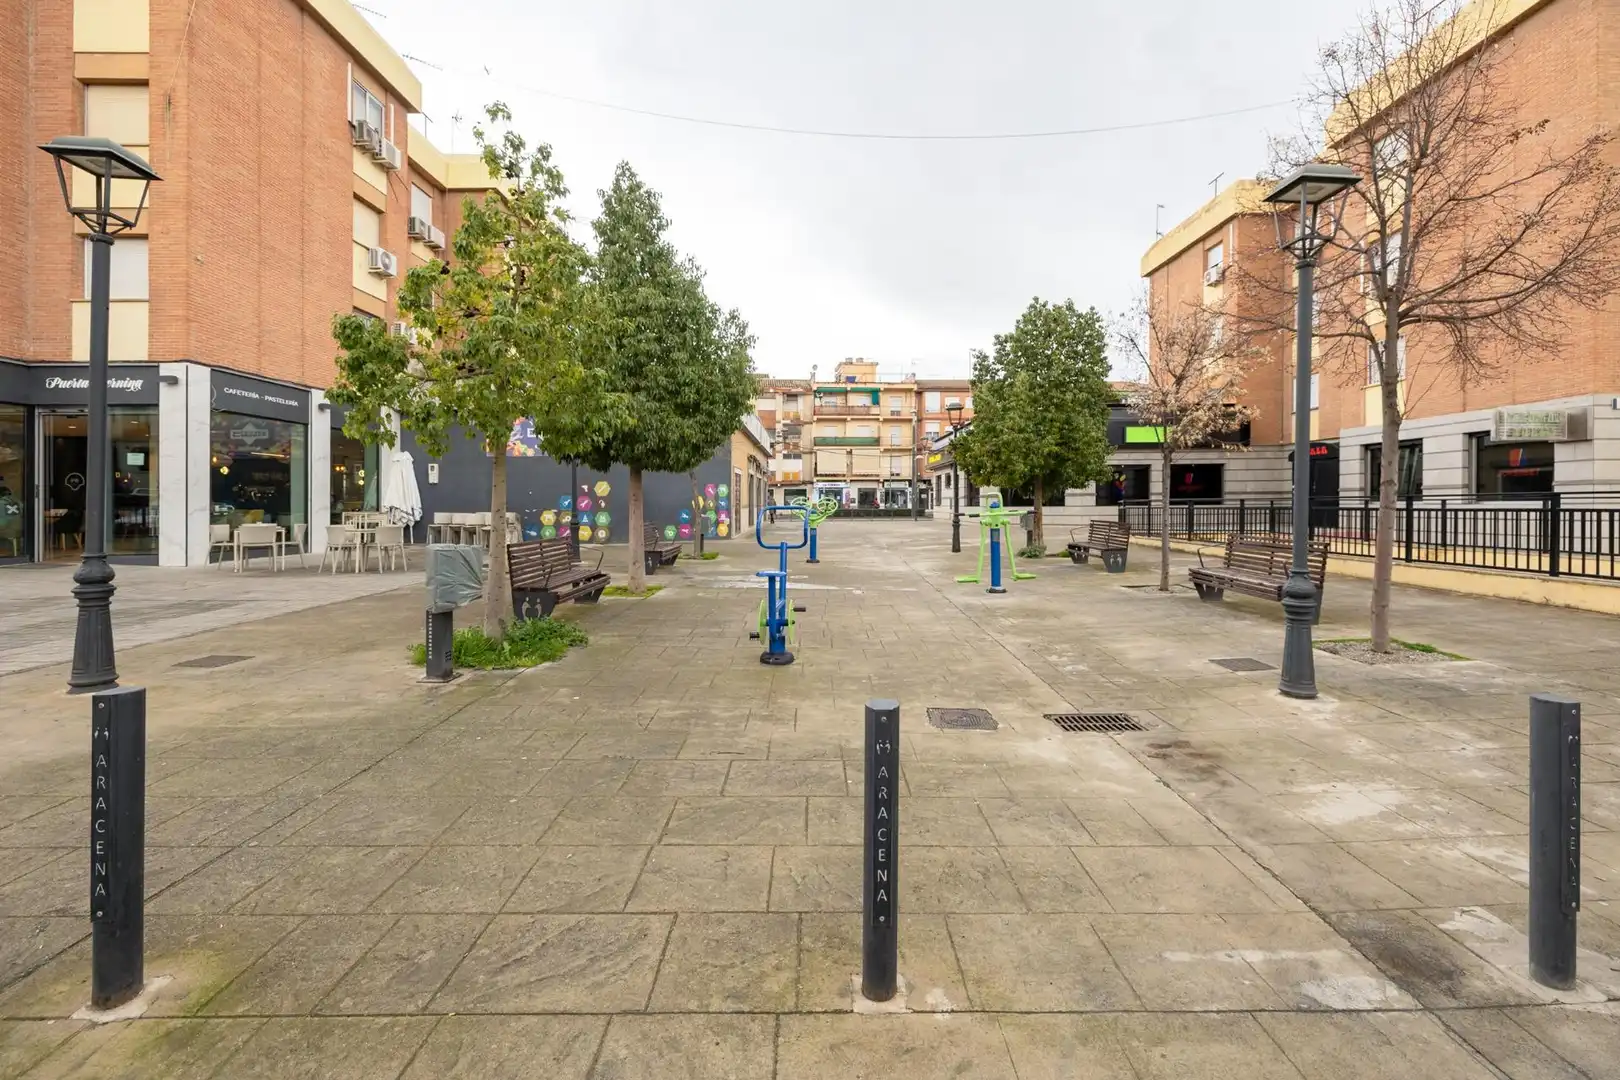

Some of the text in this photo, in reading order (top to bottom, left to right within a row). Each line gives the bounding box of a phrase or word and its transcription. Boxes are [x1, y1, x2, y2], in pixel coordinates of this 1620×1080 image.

[45, 377, 90, 389] Puerta
[223, 387, 260, 399] CAFETERÍA
[264, 395, 299, 407] PASTELERÍA
